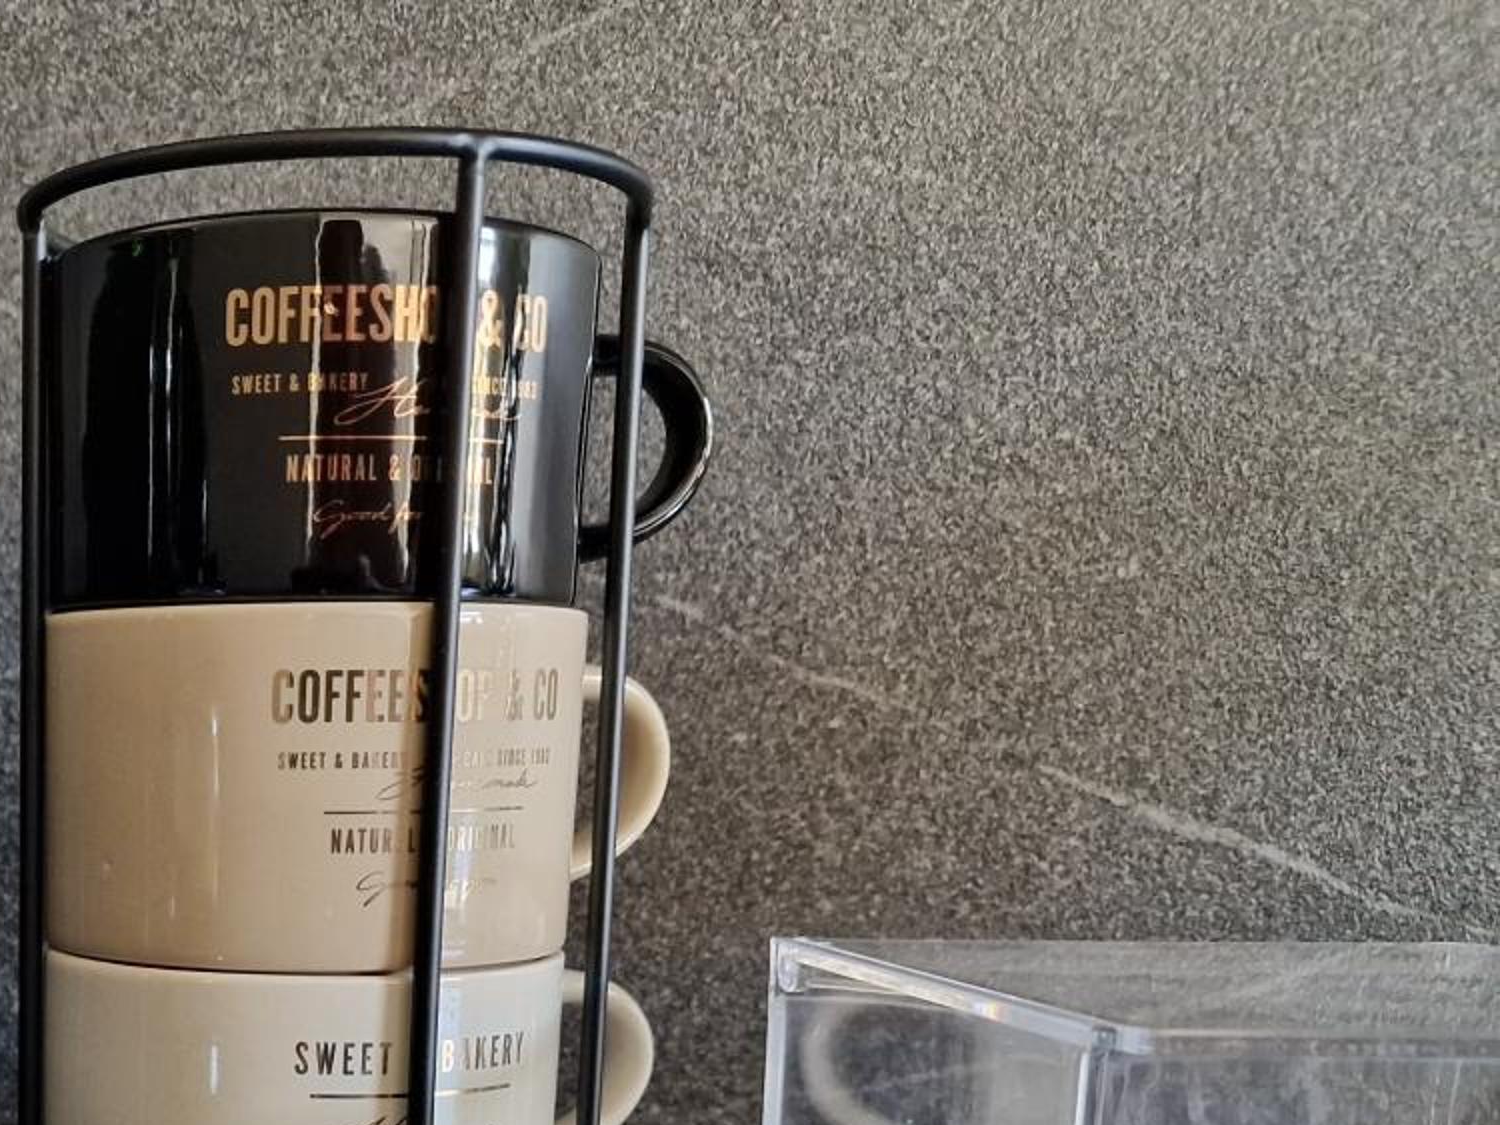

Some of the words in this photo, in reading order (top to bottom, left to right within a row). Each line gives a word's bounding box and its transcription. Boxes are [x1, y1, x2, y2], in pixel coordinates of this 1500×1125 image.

[225, 284, 438, 347] COFFEESHO
[231, 374, 282, 395] SWEET
[289, 373, 299, 392] &
[308, 372, 369, 392] BAKERY
[285, 454, 377, 482] NATURAL
[388, 454, 400, 481] &
[533, 668, 558, 721] CO
[278, 752, 325, 770] SWEET
[334, 752, 343, 769] &
[351, 752, 406, 769] BAKER
[331, 828, 417, 854] NATURL
[294, 1041, 392, 1075] SWEET
[441, 1032, 524, 1073] BAKERY
